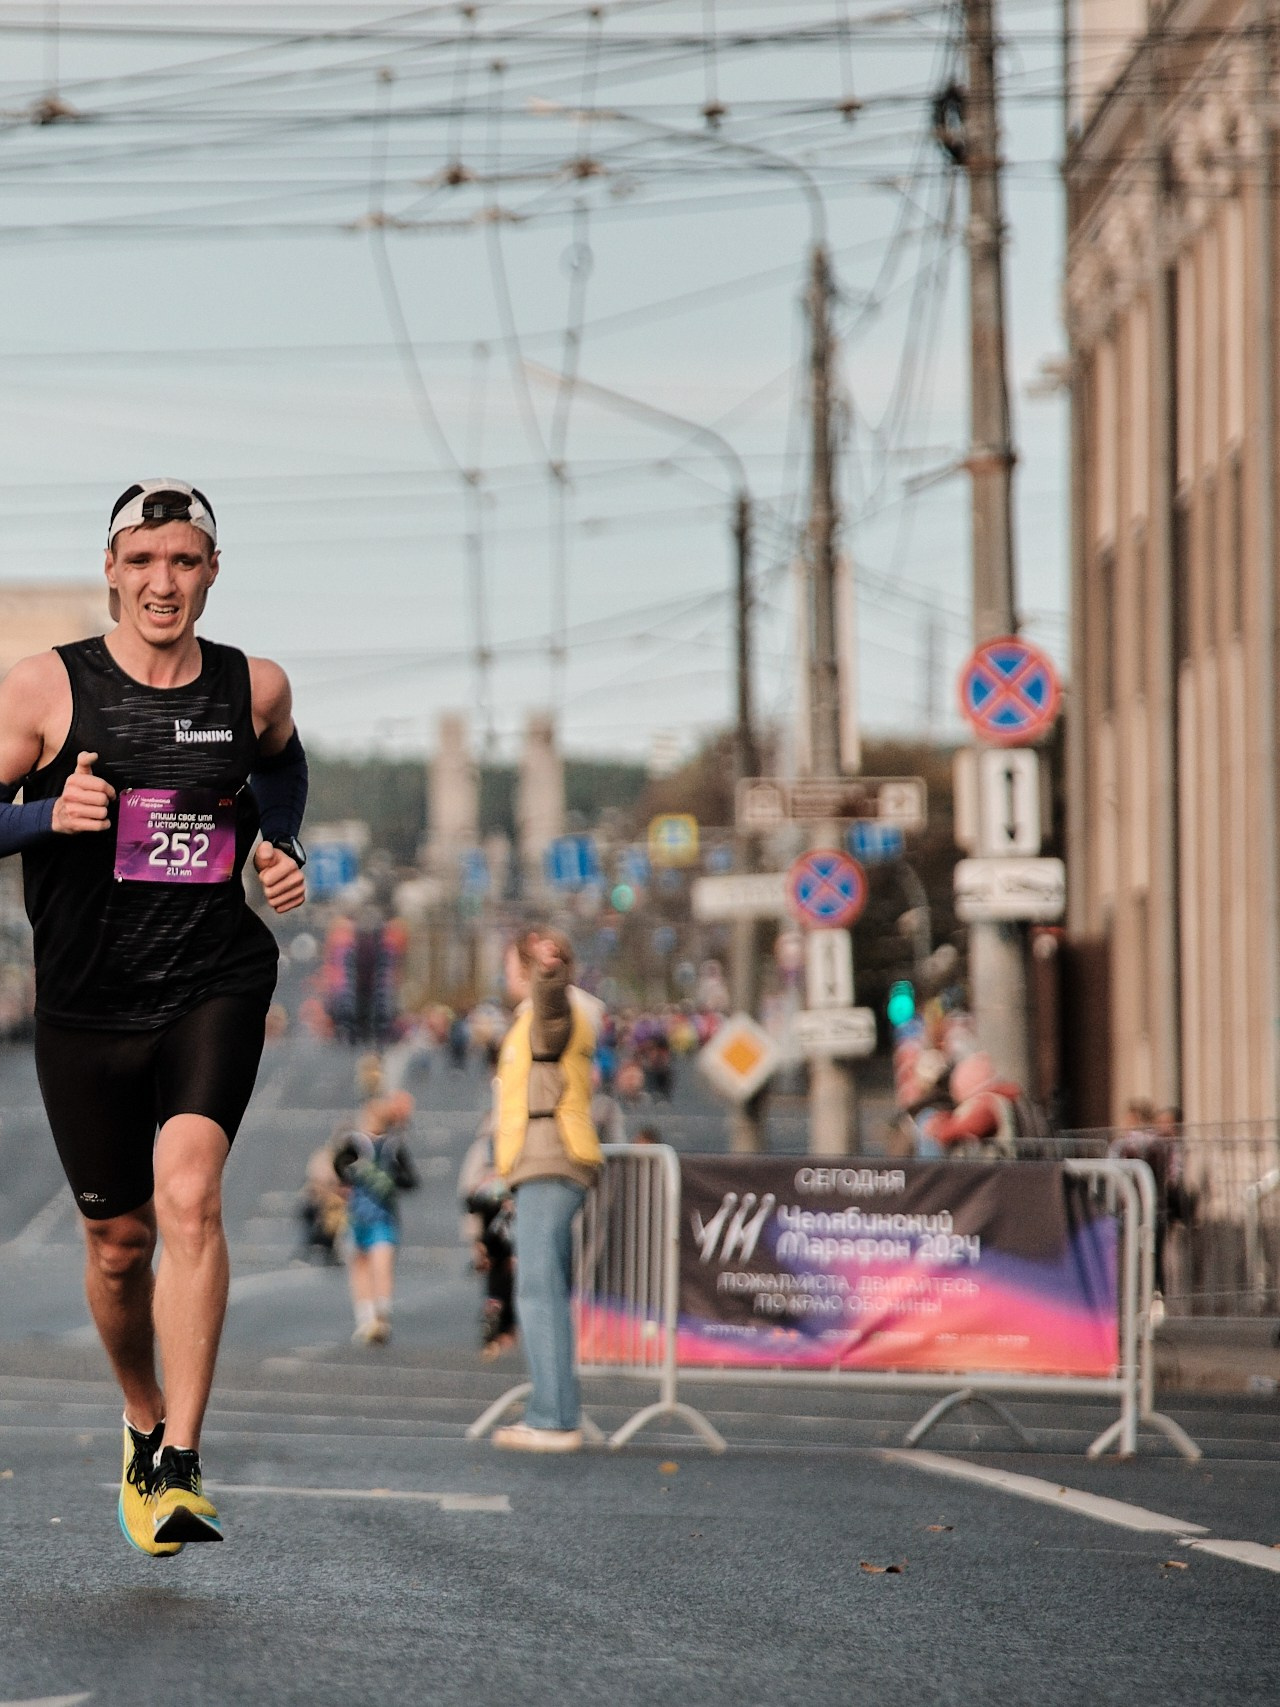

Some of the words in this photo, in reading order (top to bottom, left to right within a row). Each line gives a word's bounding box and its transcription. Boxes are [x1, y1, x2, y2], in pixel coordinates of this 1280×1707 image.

[175, 730, 233, 743] RUNNING
[147, 820, 154, 828] В
[190, 822, 216, 831] ГОРОДА
[149, 831, 210, 868] 252
[794, 1167, 906, 1196] СЕГОДНЯ
[776, 1204, 953, 1234] Челябинский
[776, 1230, 911, 1263] Марафон
[916, 1233, 980, 1264] 2024
[857, 1274, 980, 1295] ДВИГАЙТЕСЬ
[754, 1292, 787, 1313] ПО
[788, 1293, 843, 1314] КРАЮ
